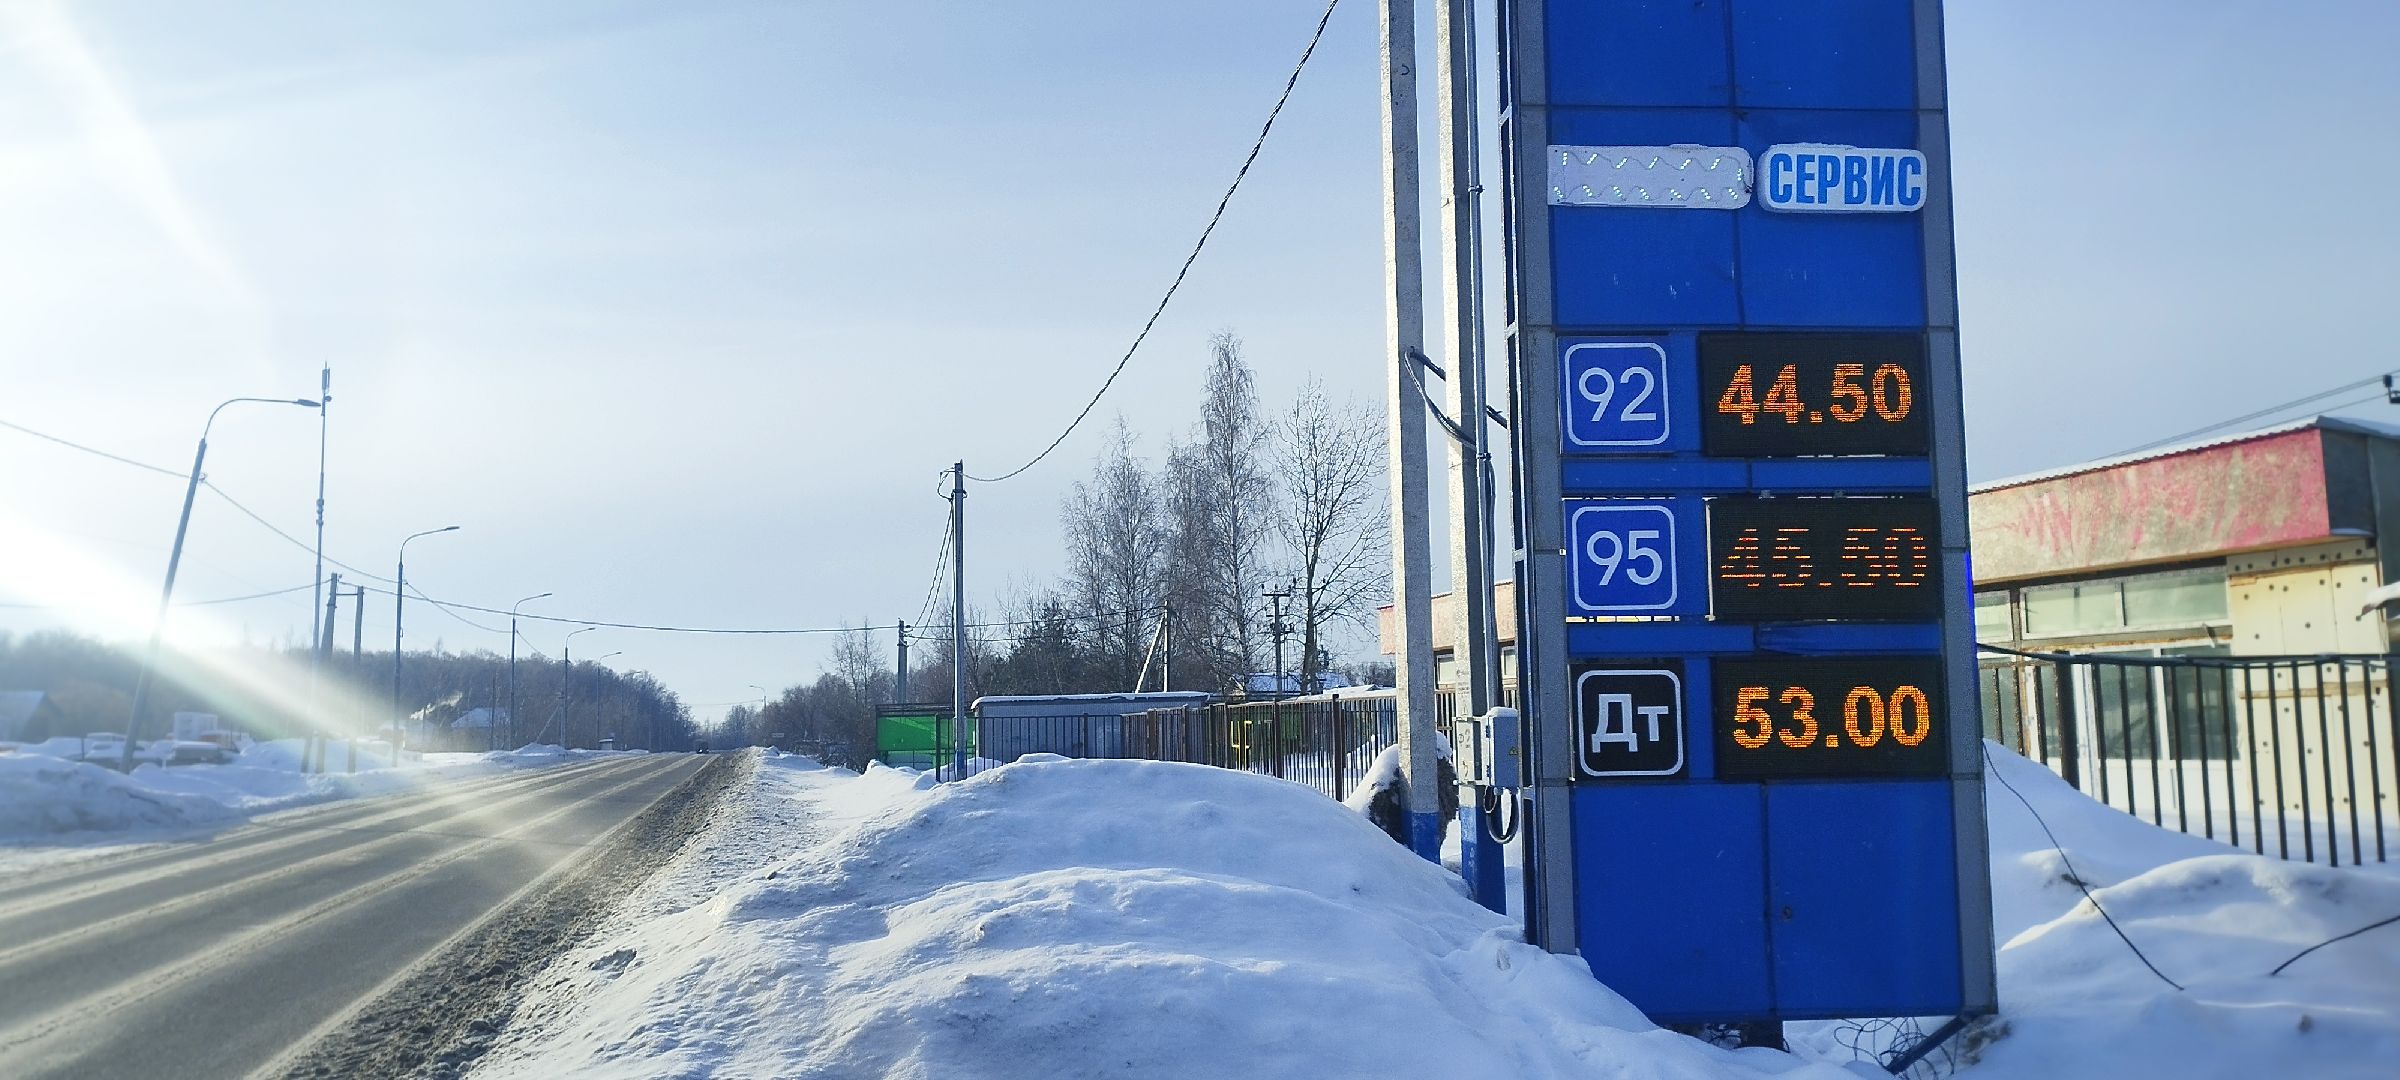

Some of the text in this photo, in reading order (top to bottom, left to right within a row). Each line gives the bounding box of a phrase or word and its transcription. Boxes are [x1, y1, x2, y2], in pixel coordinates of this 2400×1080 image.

[1769, 153, 1922, 206] СЕРВИС
[1578, 367, 1657, 422] 92
[1717, 363, 1913, 424] 44.50
[1587, 531, 1662, 586] 95
[1721, 528, 1927, 587] 45.50
[1592, 694, 1669, 753] Дт
[1733, 686, 1930, 748] 53.00
